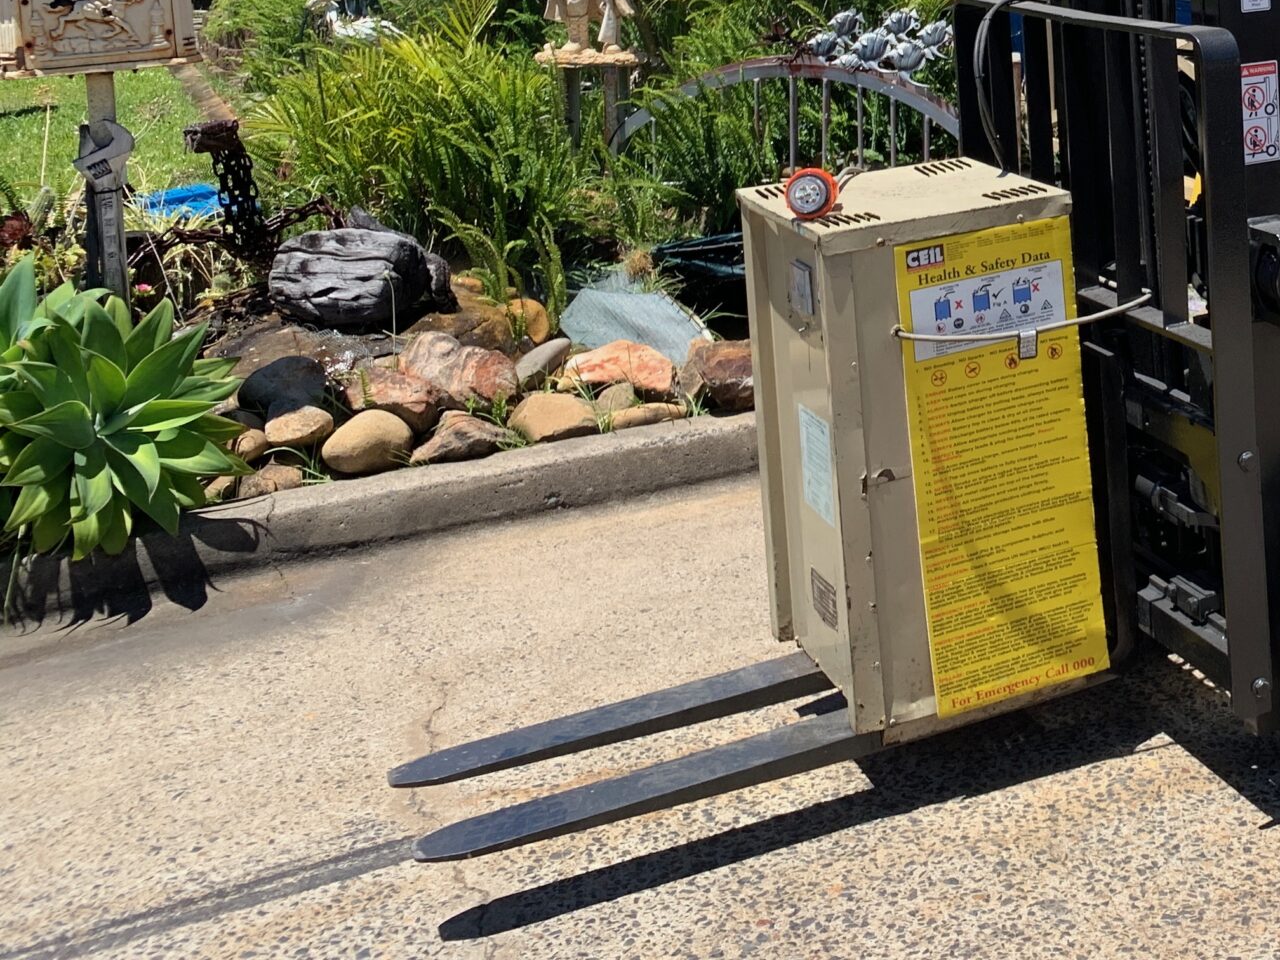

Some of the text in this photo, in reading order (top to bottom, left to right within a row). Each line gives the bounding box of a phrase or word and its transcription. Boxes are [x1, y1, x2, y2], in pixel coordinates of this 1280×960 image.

[1249, 64, 1275, 74] WARNING
[918, 267, 960, 286] Health
[965, 264, 976, 275] &
[980, 257, 1017, 272] Safety
[1021, 250, 1051, 264] Data
[951, 656, 1096, 709] For Emergency Call 000
